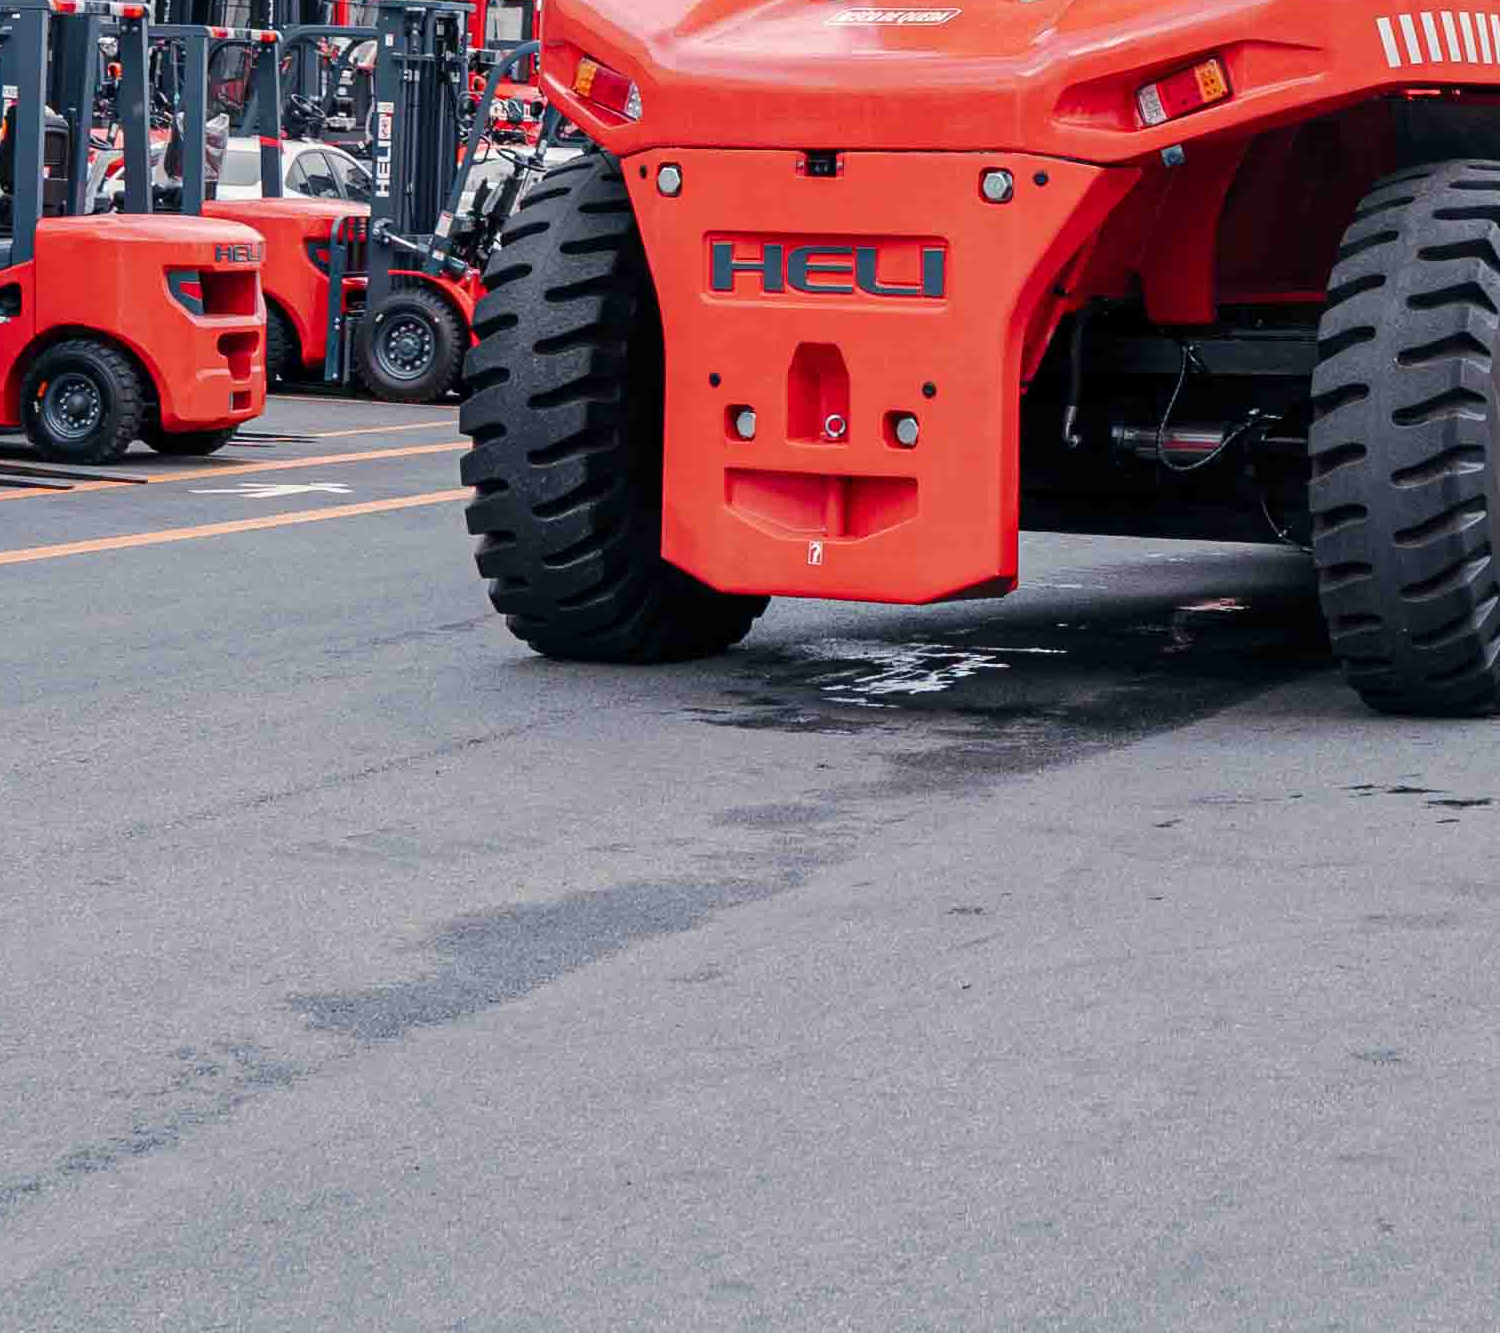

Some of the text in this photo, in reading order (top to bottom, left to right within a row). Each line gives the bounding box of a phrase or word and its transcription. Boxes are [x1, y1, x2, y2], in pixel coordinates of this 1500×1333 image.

[375, 140, 392, 197] HELI
[215, 243, 262, 262] HELI
[711, 241, 946, 298] HELI
